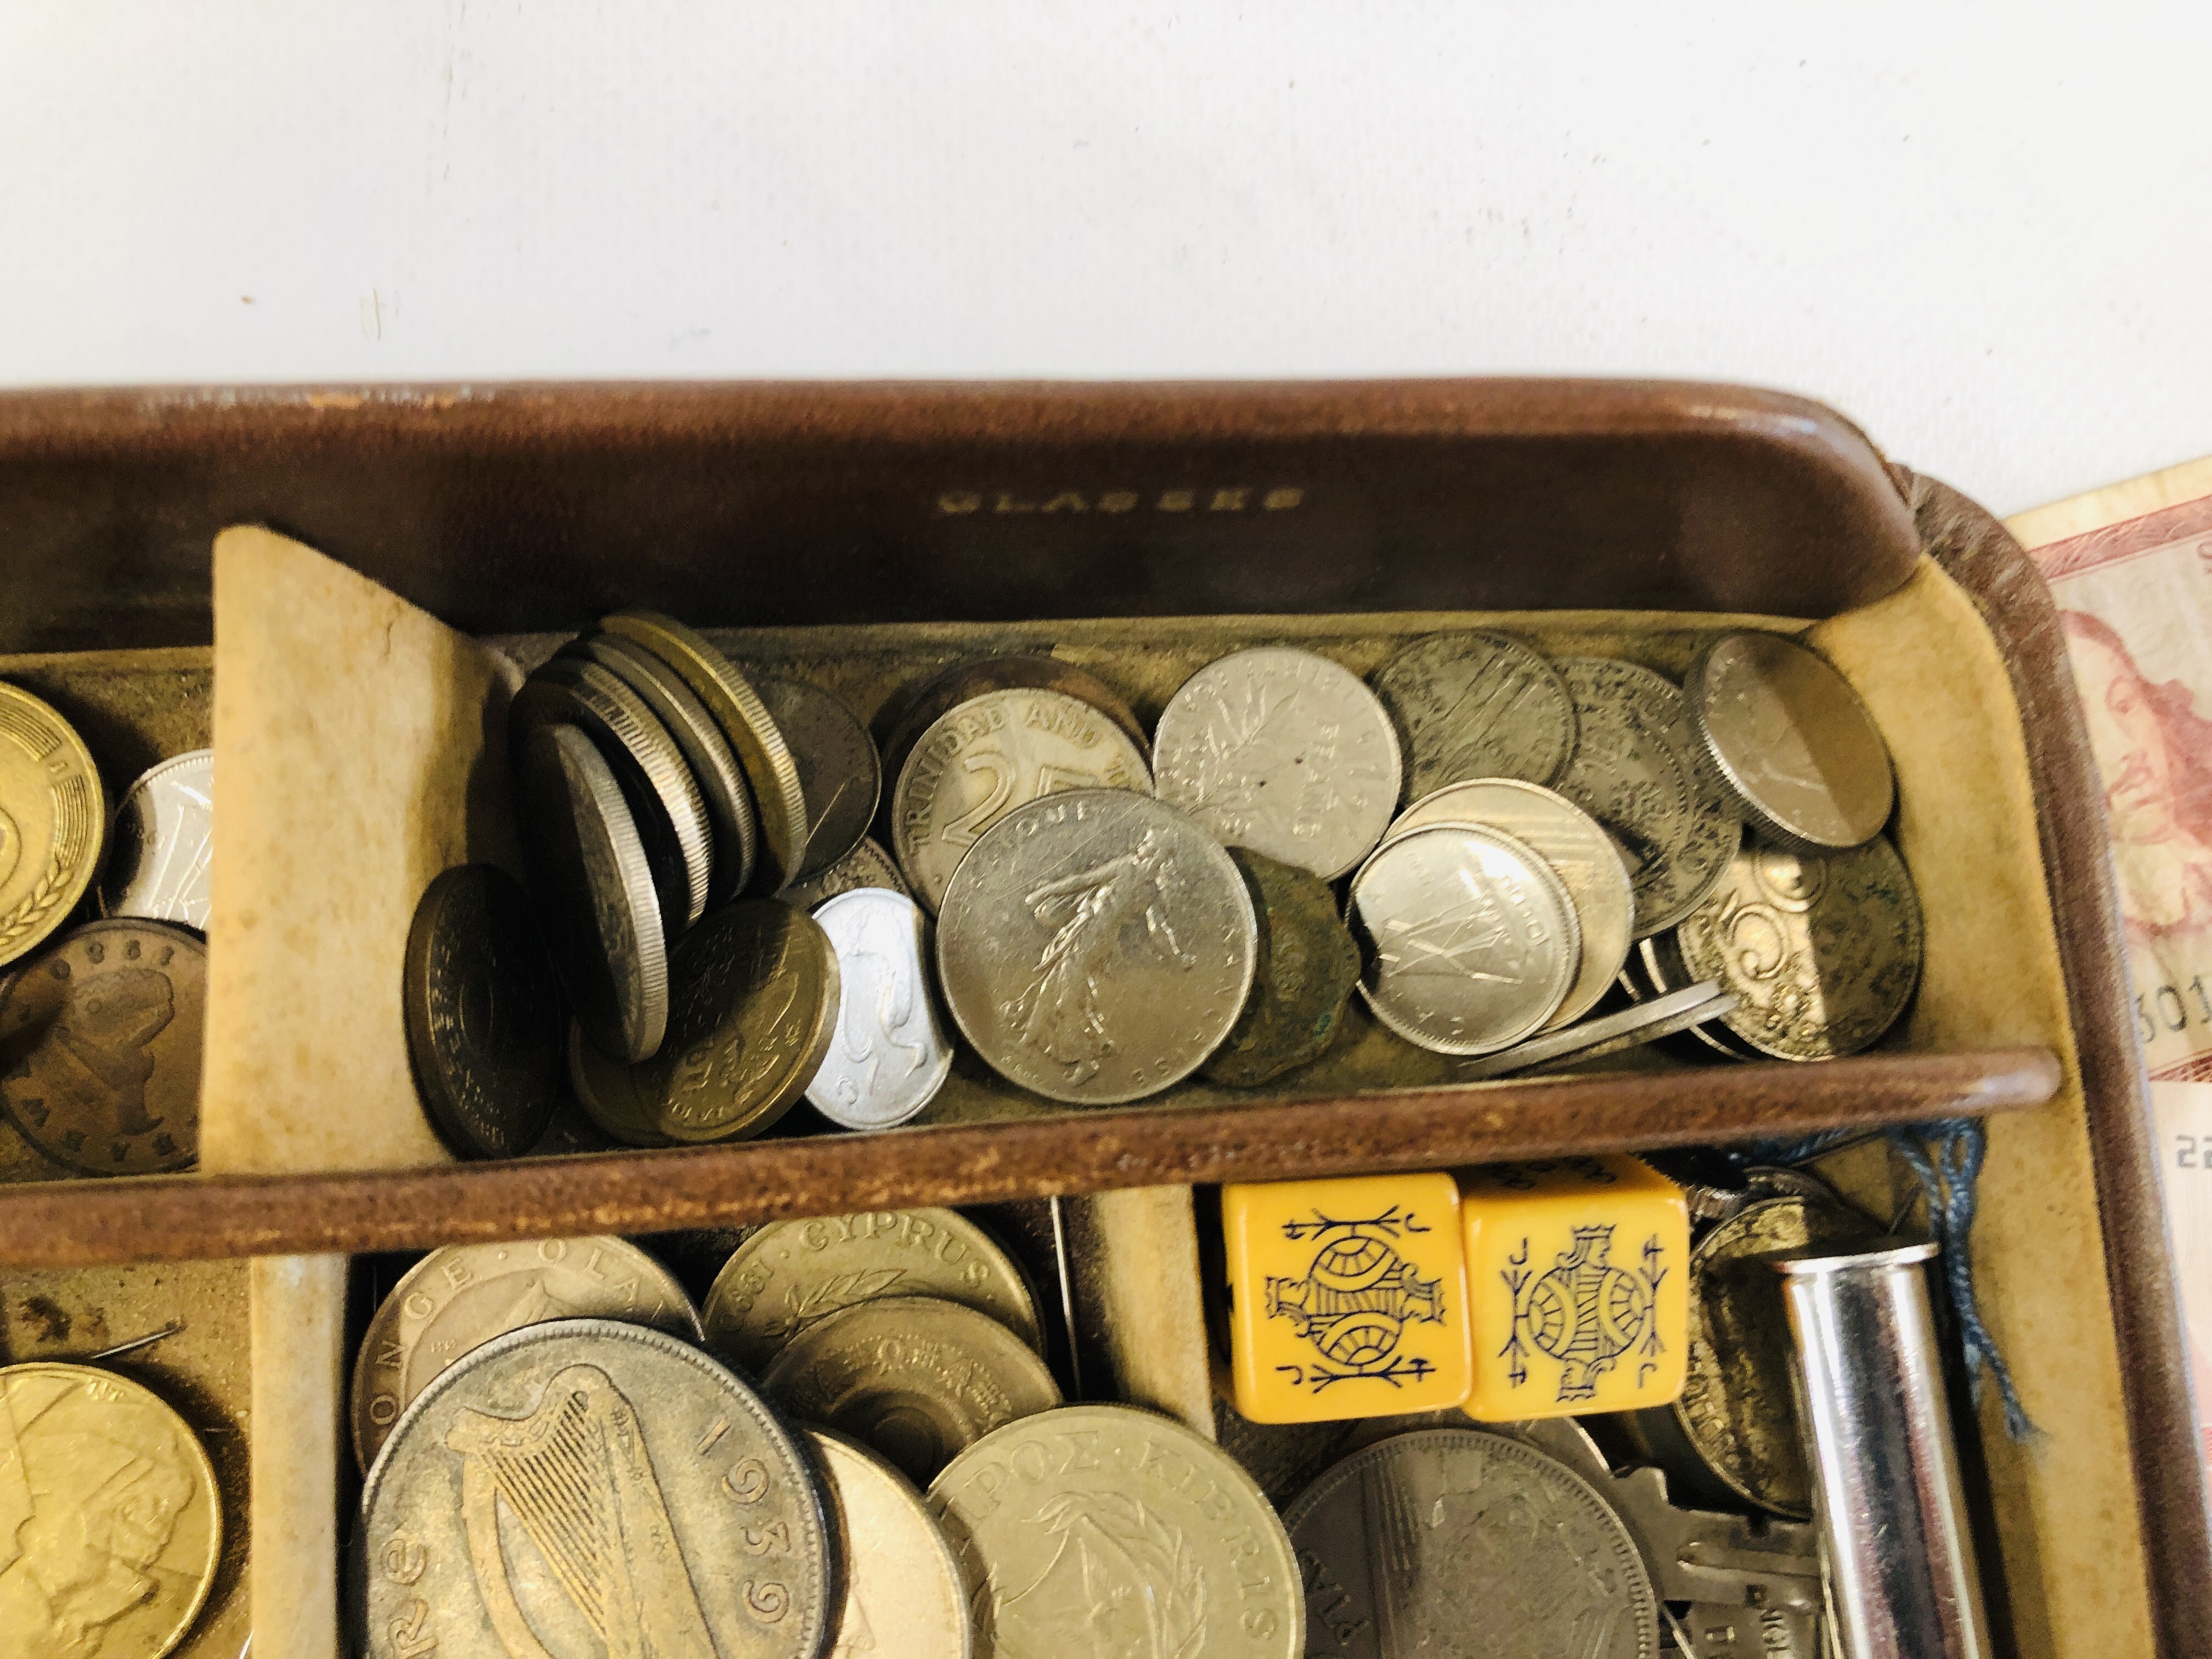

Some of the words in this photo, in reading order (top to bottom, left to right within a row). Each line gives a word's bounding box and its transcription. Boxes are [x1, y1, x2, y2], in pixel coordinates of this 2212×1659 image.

[904, 707, 1009, 853] TRINIDAD
[1025, 702, 1101, 749] AND
[799, 1210, 991, 1288] CYPRUS
[370, 1256, 475, 1425] ONGE
[697, 1418, 792, 1624] 1939
[1135, 1441, 1279, 1640] KIBRIS
